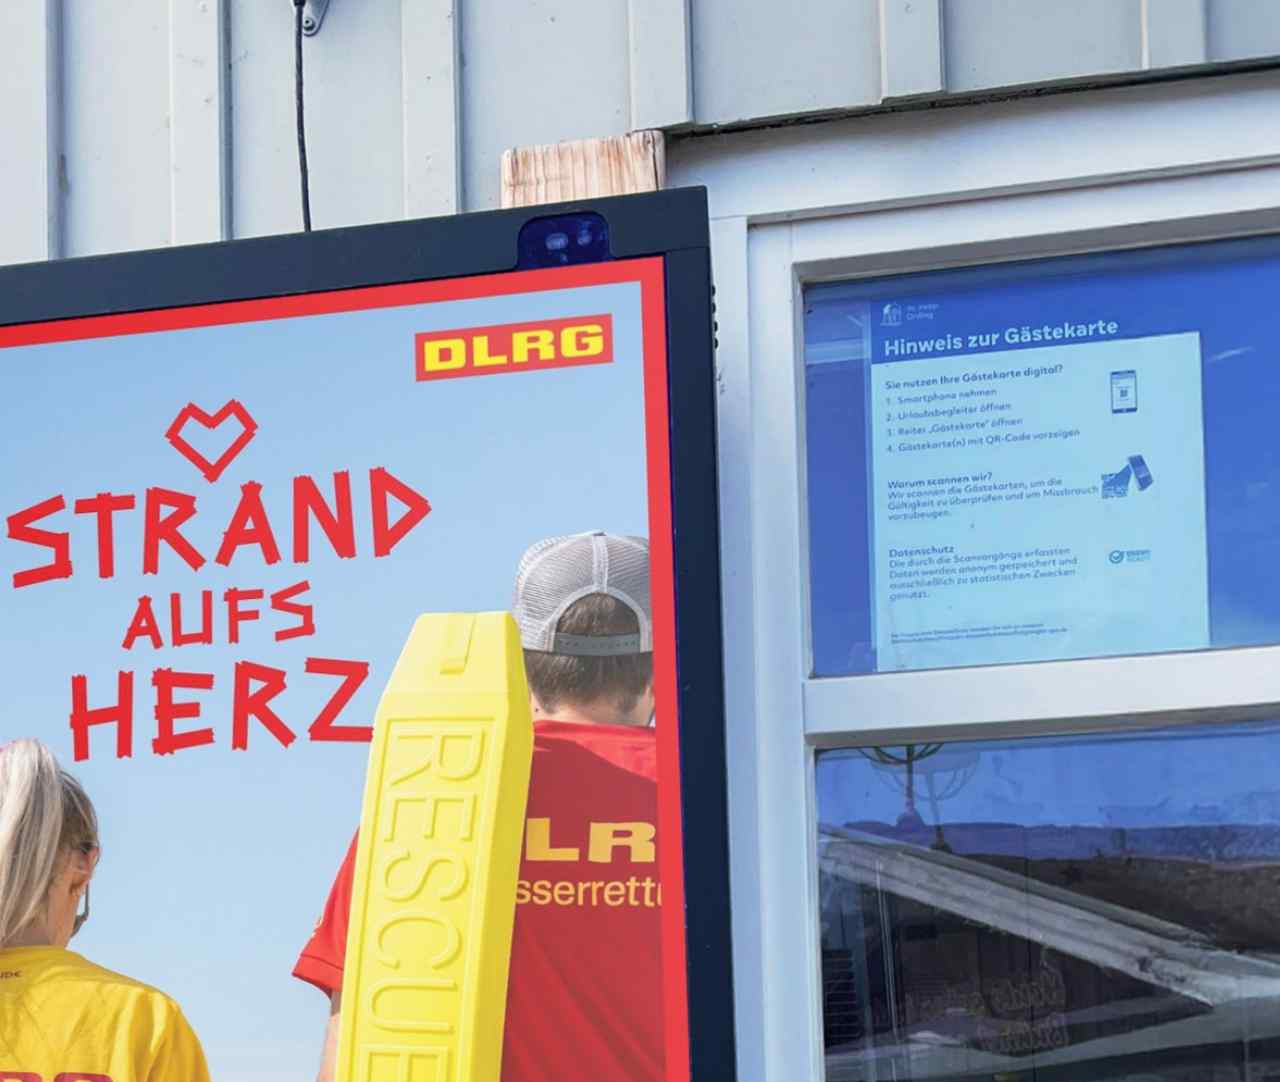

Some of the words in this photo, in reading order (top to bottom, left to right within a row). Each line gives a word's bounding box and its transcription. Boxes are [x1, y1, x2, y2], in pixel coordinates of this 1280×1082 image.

[424, 324, 604, 372] DLRG
[884, 334, 962, 356] Hinweis
[967, 332, 1000, 347] zur
[1004, 319, 1119, 344] Gästekarte
[885, 380, 901, 390] Sie
[903, 377, 938, 388] nutzen
[940, 374, 960, 384] Ihre
[962, 369, 1021, 383] Gästekarte
[1023, 364, 1064, 378] digital?
[888, 479, 925, 489] Warum
[972, 472, 993, 482] wir?
[6, 466, 432, 588] STRAND
[889, 545, 954, 558] Datenschutz
[121, 580, 315, 650] AUFS
[70, 657, 373, 762] HERZ
[525, 817, 656, 864] LR
[516, 876, 662, 908] sserrett
